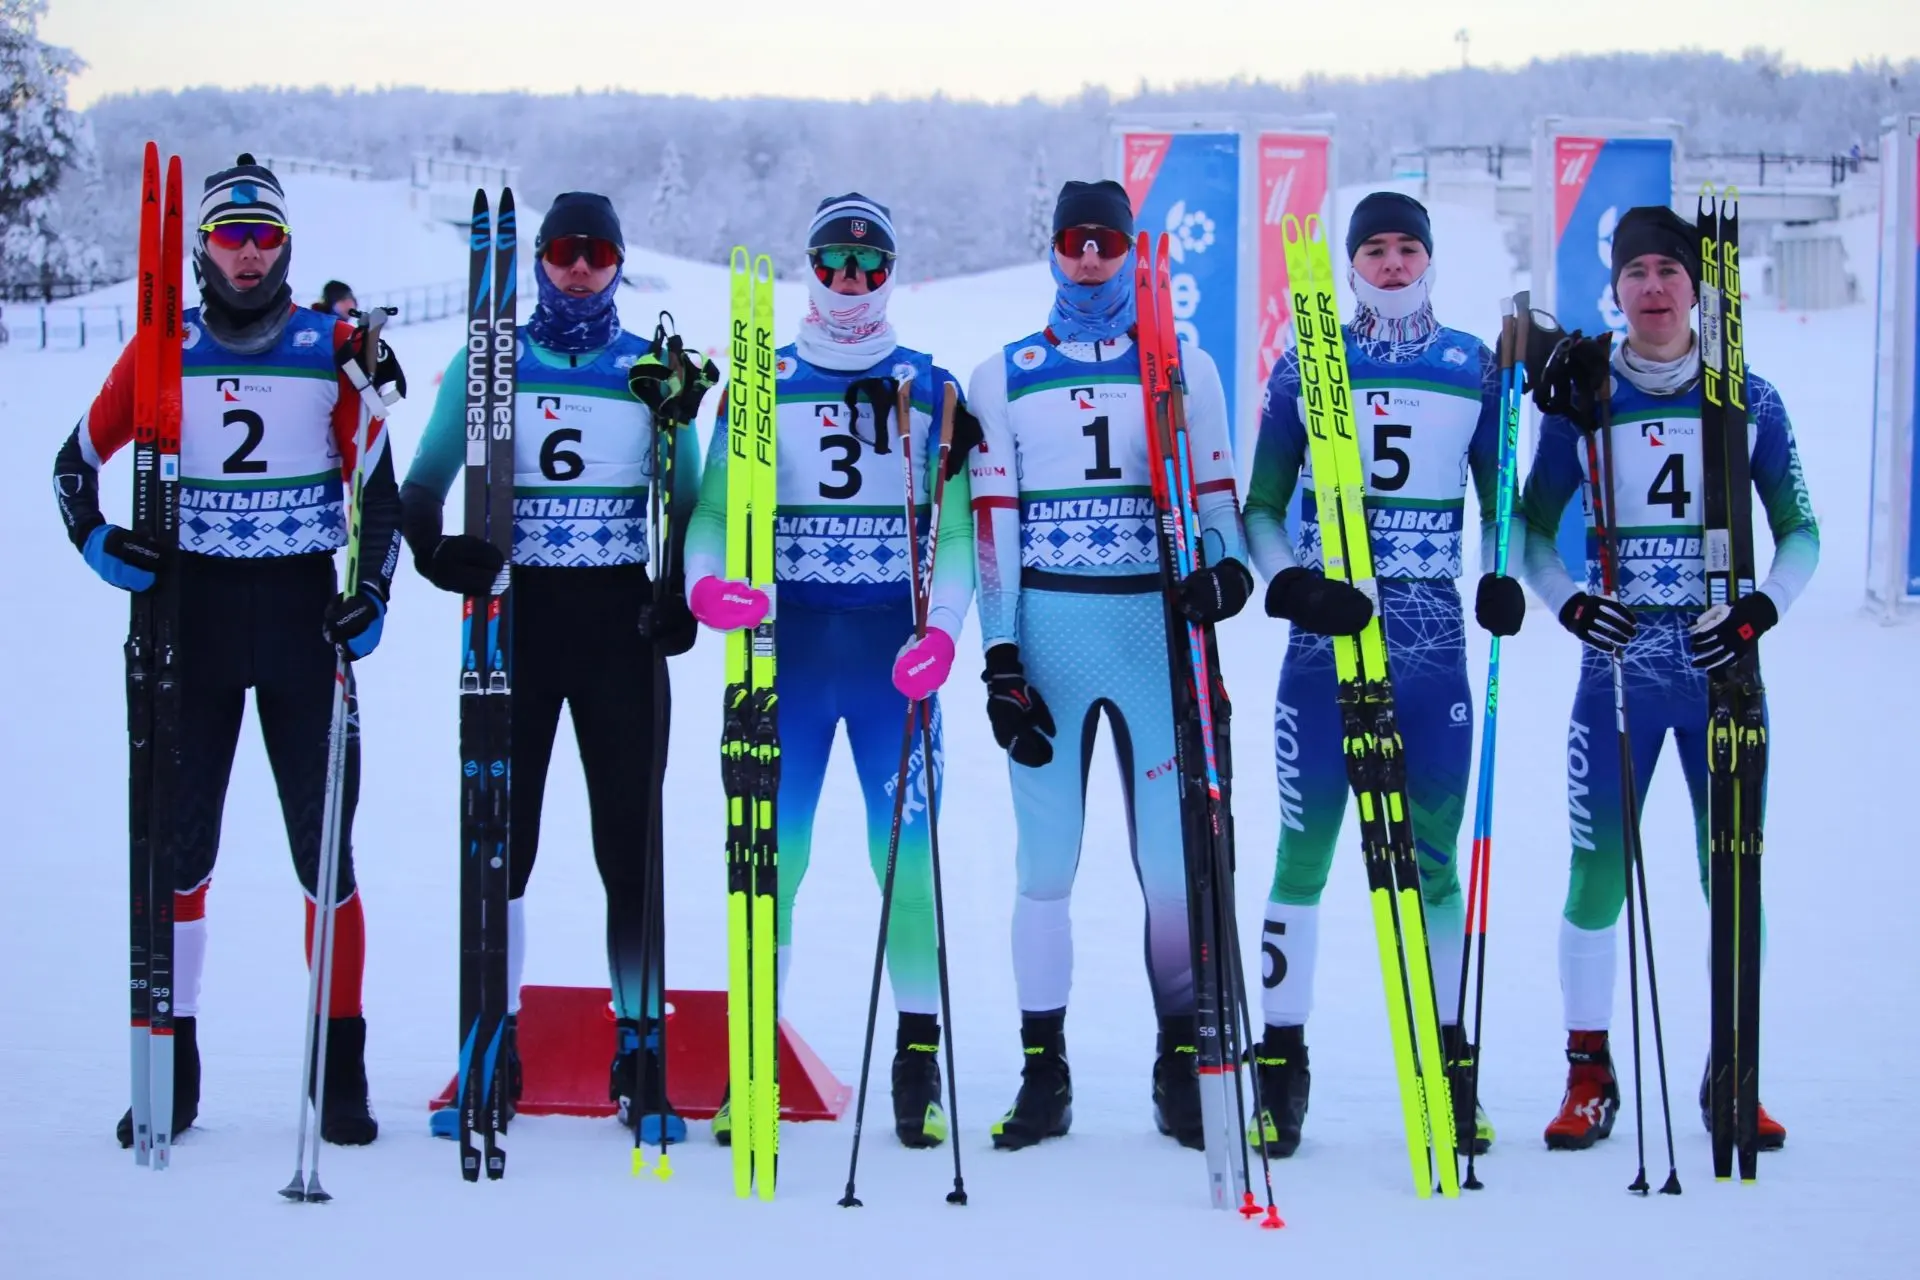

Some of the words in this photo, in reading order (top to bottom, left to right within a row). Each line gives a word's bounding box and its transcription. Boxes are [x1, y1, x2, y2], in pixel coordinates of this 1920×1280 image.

[142, 272, 155, 327] ATOMIC
[165, 285, 177, 339] ATOMIC
[1701, 236, 1723, 407] FIER
[1723, 241, 1746, 411] FISCHER
[732, 318, 749, 459] FISCHER
[756, 327, 773, 467] FISCHER
[1295, 292, 1327, 440] FISCHER
[1317, 291, 1352, 440] FISCHER
[222, 409, 268, 474] 2
[539, 428, 585, 481] 6
[818, 434, 863, 500] 3
[971, 466, 1006, 477] VIUM
[1082, 415, 1122, 481] 1
[1370, 424, 1412, 491] 5
[139, 472, 147, 520] REDSTER
[179, 485, 325, 510] ЫКТЫВКАР
[512, 499, 635, 517] КТЫВКАР
[1027, 497, 1153, 521] СЫКТЫВК
[1647, 453, 1691, 519] 4
[777, 517, 918, 536] ЫКТЫВКА
[1367, 508, 1453, 530] ТЫВКАР
[1275, 700, 1305, 832] КОМИ
[1567, 718, 1596, 851] КОМИ
[130, 979, 148, 989] S9
[1261, 919, 1288, 989] 5
[152, 987, 170, 997] S9
[1199, 1026, 1217, 1037] S9
